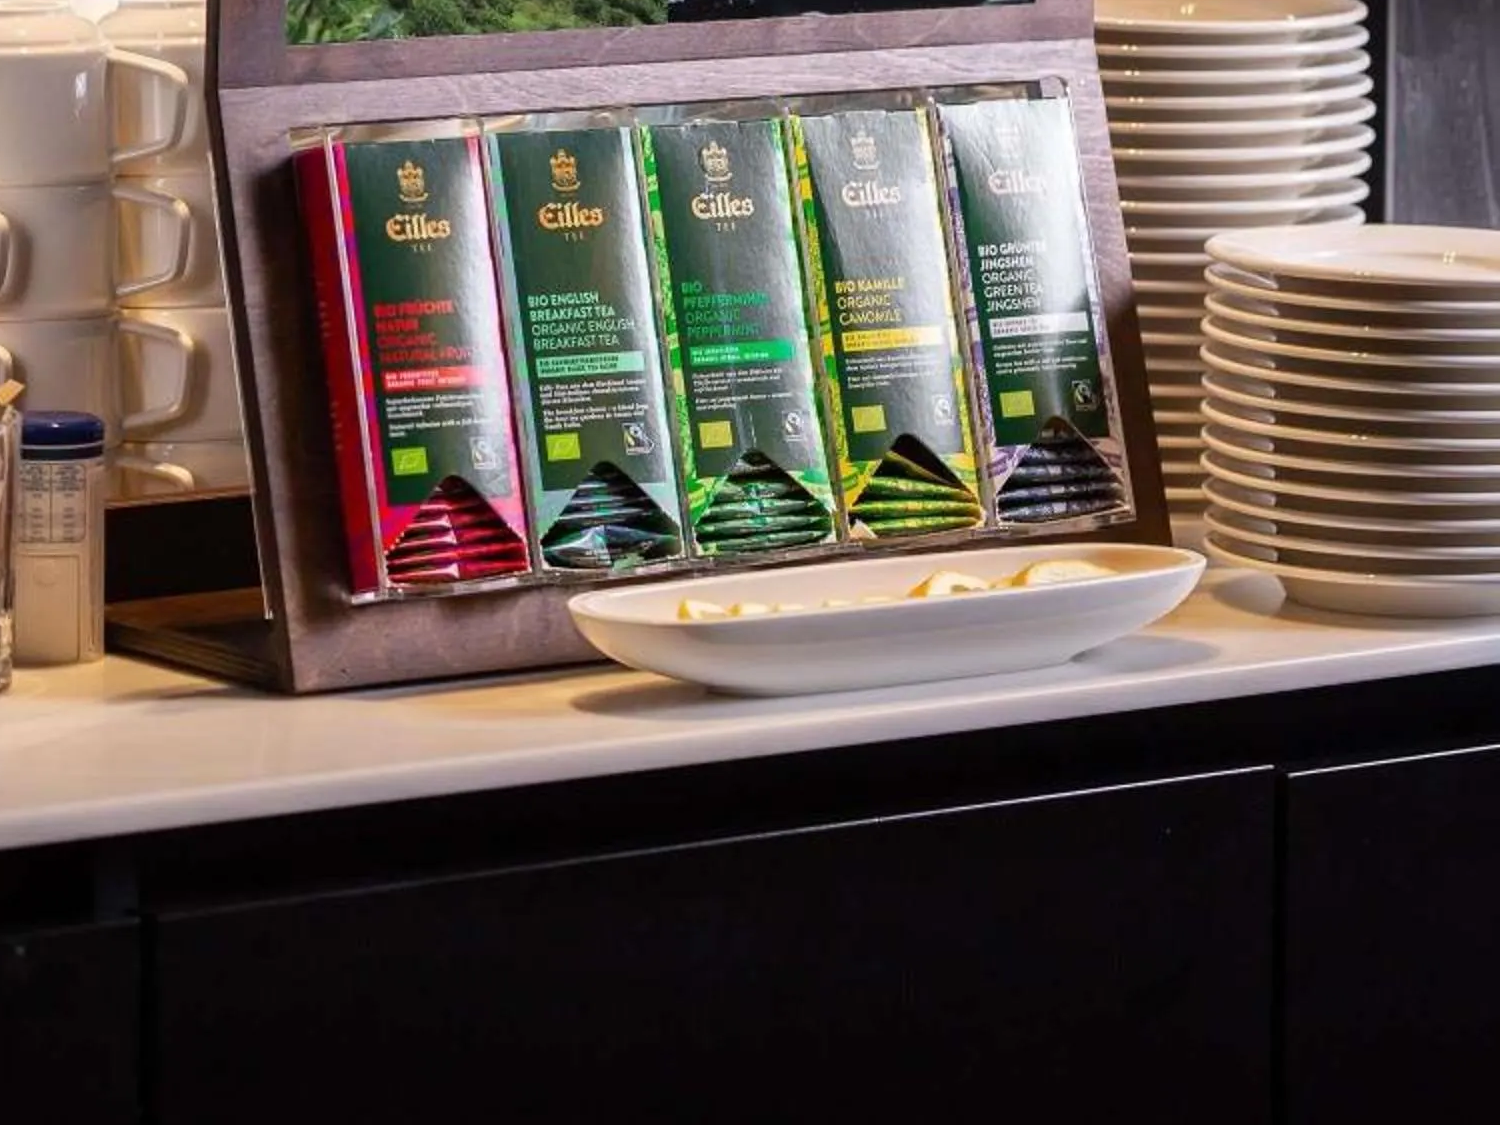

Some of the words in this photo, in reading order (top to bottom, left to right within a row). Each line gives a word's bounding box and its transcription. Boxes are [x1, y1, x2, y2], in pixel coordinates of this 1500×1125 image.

[841, 180, 902, 207] Eilles
[691, 191, 755, 219] Eilles
[538, 201, 604, 229] Eilles
[385, 212, 451, 241] Eilles
[977, 244, 998, 257] BIO
[981, 269, 1035, 284] ORGANIC
[681, 281, 702, 294] BIO
[835, 280, 855, 294] BIO
[857, 277, 905, 292] KAMILLE
[984, 284, 1023, 298] GREEN
[1023, 282, 1043, 295] TEA
[527, 295, 549, 308] BIO
[551, 291, 599, 306] ENGLISH
[837, 294, 891, 309] ORGANIC
[529, 306, 593, 322] BREAKFAST
[594, 304, 616, 318] TEA
[839, 309, 902, 325] CAMOMILE
[531, 321, 587, 336] ORGANIC
[588, 318, 636, 333] ENGLISH
[533, 335, 597, 351] BREAKFAST
[598, 334, 620, 348] TEA
